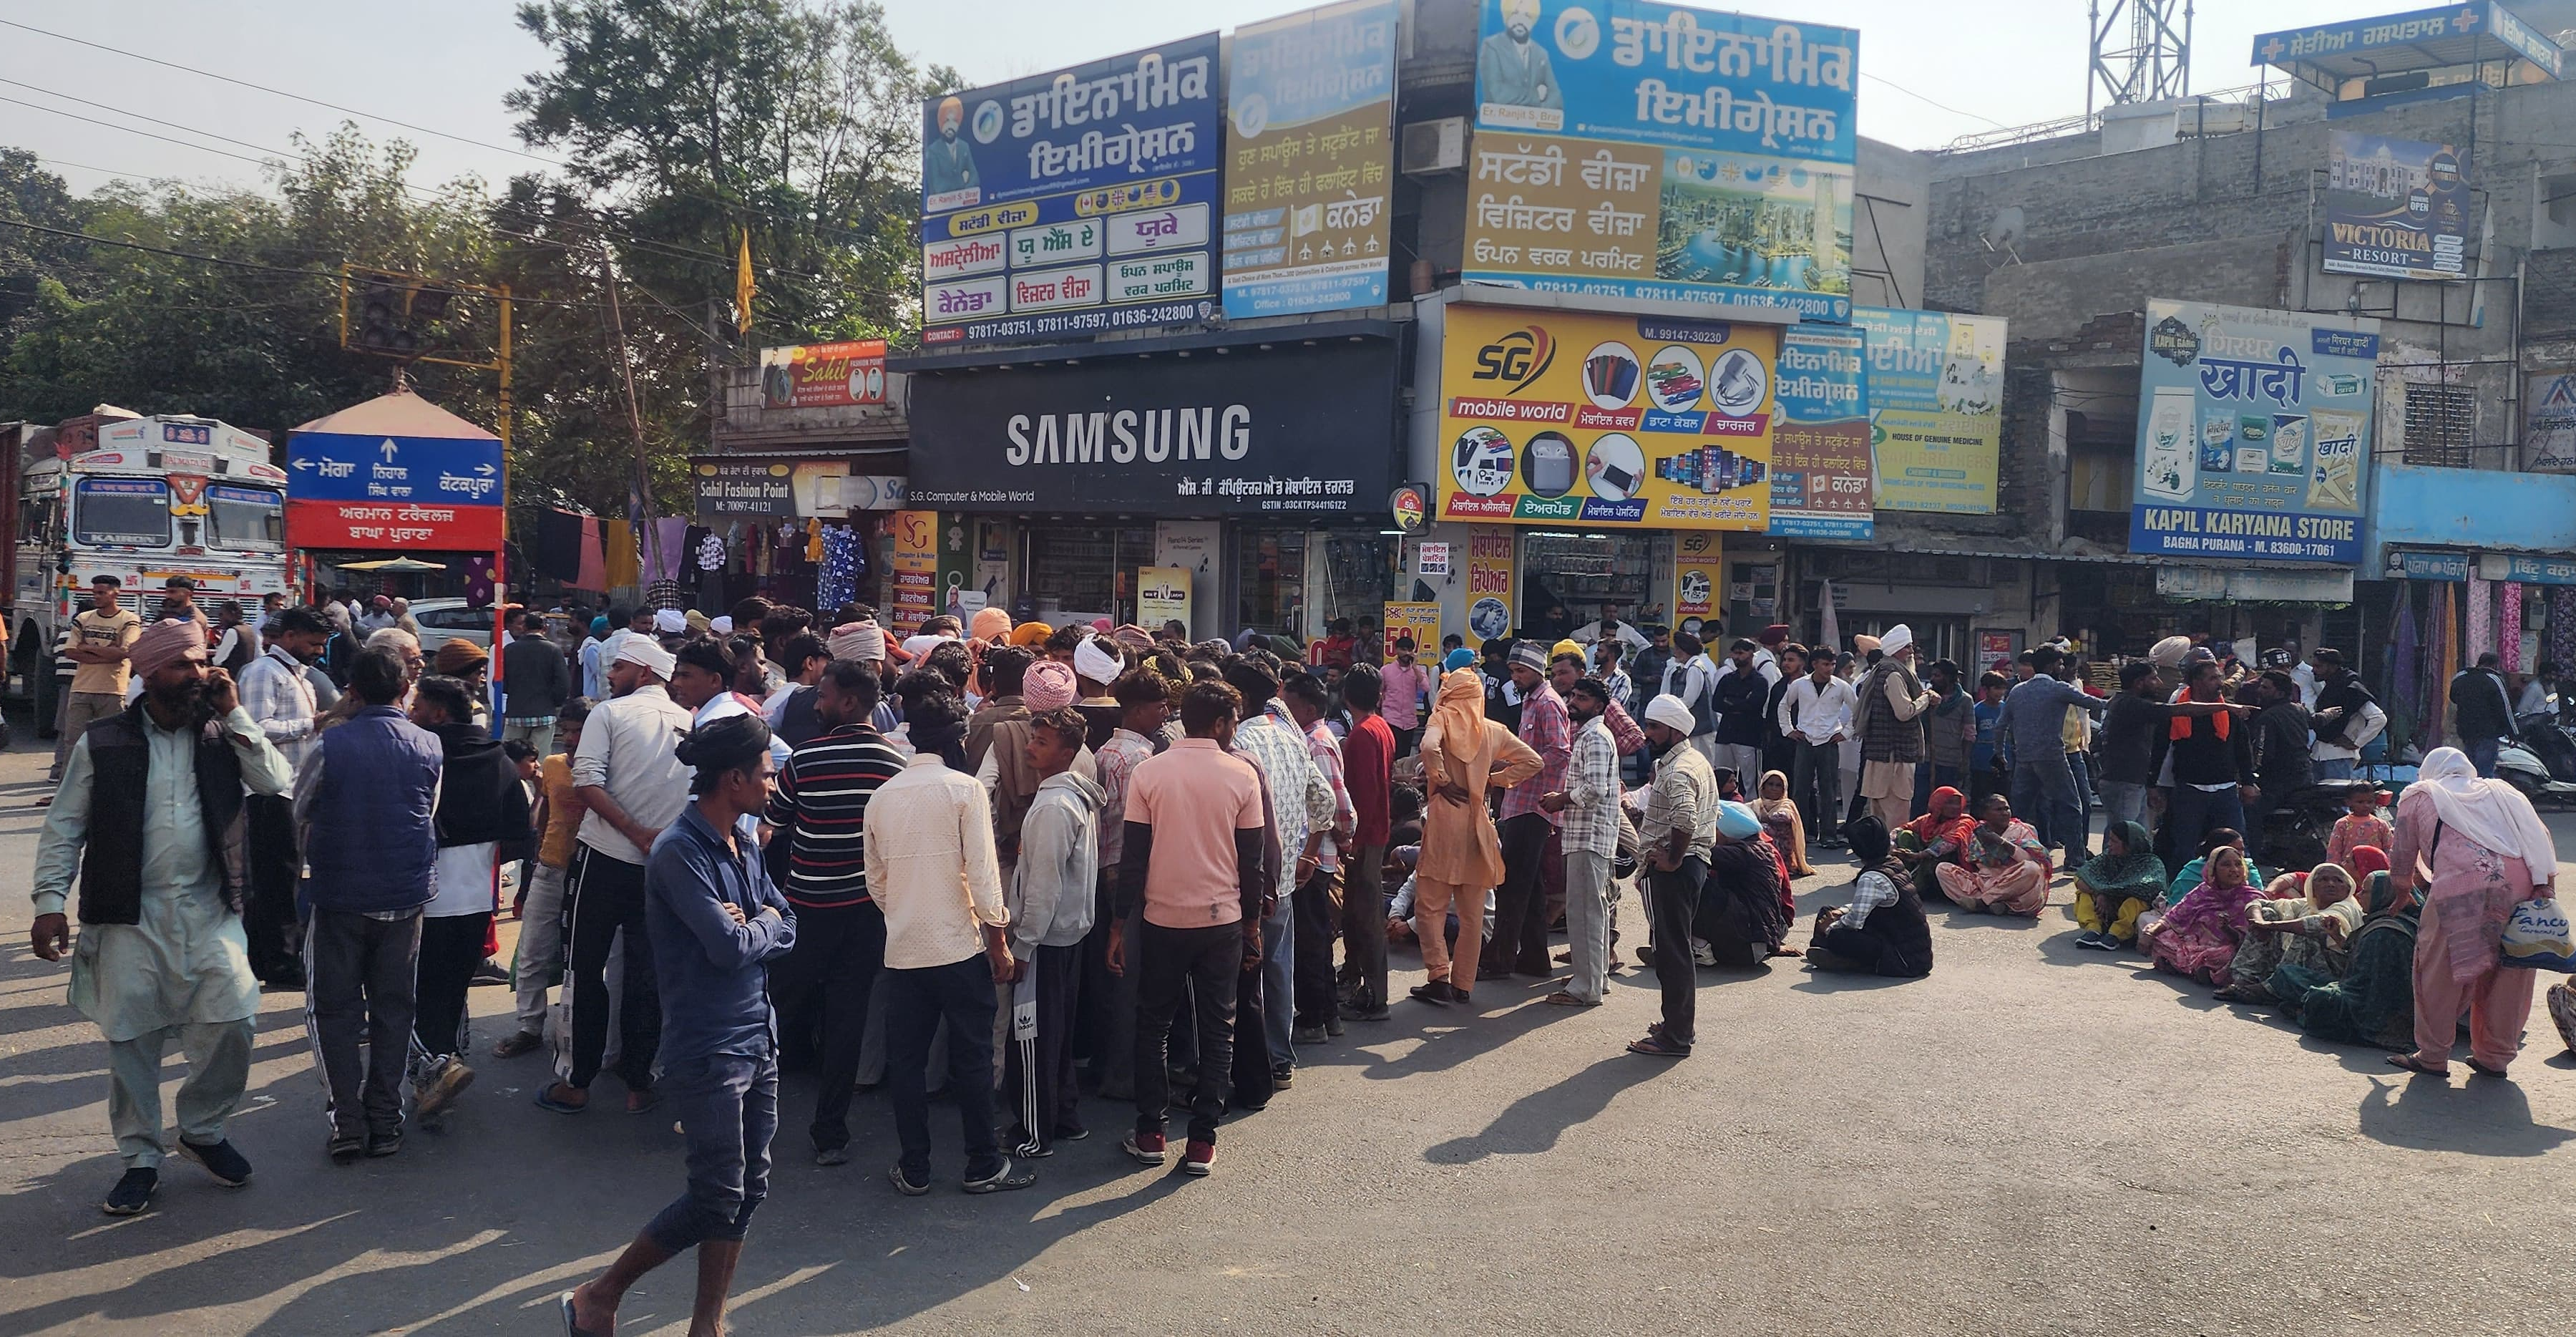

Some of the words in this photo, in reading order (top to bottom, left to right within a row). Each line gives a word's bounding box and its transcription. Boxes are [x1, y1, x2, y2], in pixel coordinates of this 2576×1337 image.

[2363, 17, 2446, 45] ਹਸਪਤਾਲ
[1611, 11, 1851, 91] ਡਾਇਨਾਮਿਕ
[1011, 53, 1209, 137] ਡਾਇਨਾਮਿਕ
[1498, 109, 1526, 121] Ranjit
[1528, 111, 1539, 120] S.
[1541, 112, 1561, 122] Brar
[1634, 79, 1838, 149] ਇਮੀਗ੍ਰੇਸ਼ਨ
[1028, 122, 1196, 179] ਇਮੀਗ੍ਰੇਸ਼ਨ
[1305, 132, 1317, 155] ਤੇ
[1365, 127, 1380, 146] ਜਾ
[1477, 142, 1566, 187] ਸਟੱਡੀ
[1581, 149, 1651, 193] ਵੀਜ਼ਾ
[1231, 180, 1257, 204] ਸਕਦੇ
[1261, 178, 1270, 199] ਹੋ
[1299, 171, 1311, 194] ਹੀ
[1316, 165, 1358, 191] ਫਲਾਇਟ
[1362, 161, 1385, 185] ਵਿੱਚ
[1327, 189, 1383, 230] ਕਨੇਡਾ
[1477, 193, 1576, 232] ਵਿਜ਼ਿਟਰ
[1586, 200, 1646, 237] ਵੀਜ਼ਾ
[2410, 202, 2429, 212] OPEN
[960, 213, 990, 231] ਸਟੱਡੀ
[1136, 213, 1177, 246] ਯੂਕੇ
[1018, 238, 1034, 263] ਯੂ
[1081, 226, 1093, 247] ਏ
[2332, 222, 2431, 252] VICTORIA
[930, 242, 1000, 271] ਅਸਟ੍ਰੇਲੀਆ
[1473, 238, 1521, 263] ਓਪਨ
[1528, 247, 1573, 266] ਵਰਕ
[1581, 245, 1643, 271] ਪਰਮਿਟ
[2353, 248, 2409, 265] RESORT
[1125, 283, 1148, 296] ਵਰਕ
[1155, 280, 1193, 292] ਪਰਮਿਟ
[938, 290, 992, 313] ਕੈਨੇਡਾ
[1254, 300, 1279, 309] Office
[1734, 294, 1829, 315] 01636-242800
[969, 321, 1035, 339] 97817-03751,
[1038, 313, 1109, 331] 97811-97597,
[1113, 305, 1194, 325] 01636-242800
[1645, 328, 1657, 339] M.
[1659, 329, 1722, 343] 99147-30230
[2155, 334, 2175, 348] KAPIL
[2205, 327, 2275, 359] गिरधर
[2353, 334, 2368, 348] खादी
[801, 356, 850, 383] Sahil
[1473, 342, 1535, 382] SG
[2200, 345, 2308, 409] खादी
[1457, 400, 1516, 417] mobile
[1520, 402, 1568, 419] world
[1580, 412, 1614, 427] ਮੋਬਾਇਲ
[1616, 415, 1636, 428] ਕਵਰ
[1649, 416, 1672, 428] ਡਾਟਾ
[1673, 415, 1699, 429] ਕੇਬਲ
[1716, 418, 1757, 432] ਚਾਰਜਰ
[1005, 404, 1251, 467] SAMSUNG
[1785, 431, 1812, 450] ਸਪਾਊਸ
[1815, 432, 1822, 446] ਤੇ
[1853, 437, 1862, 447] ਜਾ
[1893, 433, 1913, 442] HOUSE
[1925, 435, 1951, 444] GENUINE
[2318, 434, 2356, 456] खादी
[318, 456, 356, 478] ਮੋਗਾ
[371, 462, 409, 480] ਨਿਹਾਲ
[1812, 454, 1820, 469] ਹੀ
[743, 465, 749, 475] ਦੀ
[751, 467, 767, 478] ਦੁਕਾਨ
[368, 483, 387, 497] ਸਿੰਘ
[390, 487, 412, 497] ਵਾਲਾ
[439, 470, 495, 499] ਕੋਟਕਪੂਰਾ
[701, 481, 723, 497] Sahil
[726, 482, 761, 498] Fashion
[763, 482, 789, 498] Point
[1202, 478, 1212, 496] ਜੀ
[1284, 477, 1322, 495] ਮੋਬਾਇਲ
[1324, 480, 1355, 495] ਵਰਲਡ
[1832, 470, 1868, 493] ਕਨੇਡਾ
[716, 501, 726, 511] M:
[726, 502, 771, 512] 70097-41121
[910, 491, 925, 501] S.G.
[926, 491, 969, 504] Computer
[970, 492, 977, 501] &
[979, 490, 1006, 502] Mobile
[1008, 490, 1035, 501] World
[1262, 501, 1281, 510] GSTIN
[1451, 497, 1479, 512] ਮੋਬਾਇਲ
[2249, 497, 2260, 506] का
[339, 506, 392, 521] ਅਰਮਾਨ
[1586, 504, 1614, 517] ਮੋਬਾਇਲ
[1616, 505, 1641, 519] ਪੇਸਟਿੰਗ
[1661, 507, 1686, 517] ਮੋਬਾਇਲ
[1701, 510, 1712, 518] ਅਤੇ
[904, 515, 927, 549] SG
[2145, 508, 2200, 533] KAPIL
[2206, 511, 2291, 538] KARYANA
[2298, 517, 2354, 541] STORE
[91, 534, 156, 543] KAIRON
[348, 527, 384, 539] ਬਾਘਾ
[389, 527, 434, 543] ਪੁਰਾਣਾ
[1471, 527, 1511, 559] ਮੋਬਾਇਲ
[1684, 539, 1703, 550] SG
[1422, 545, 1446, 553] ਮੋਬਾਇਲ
[2163, 536, 2199, 550] BAGHA
[2202, 538, 2245, 552] PURANA
[2255, 542, 2268, 553] M.
[2270, 542, 2335, 557] 83600-17061
[1423, 554, 1445, 563] ਪੇਸਟਿੰਗ
[1470, 562, 1508, 594] ਰਿਪੇਅਰ
[2509, 905, 2570, 936] Fancy
